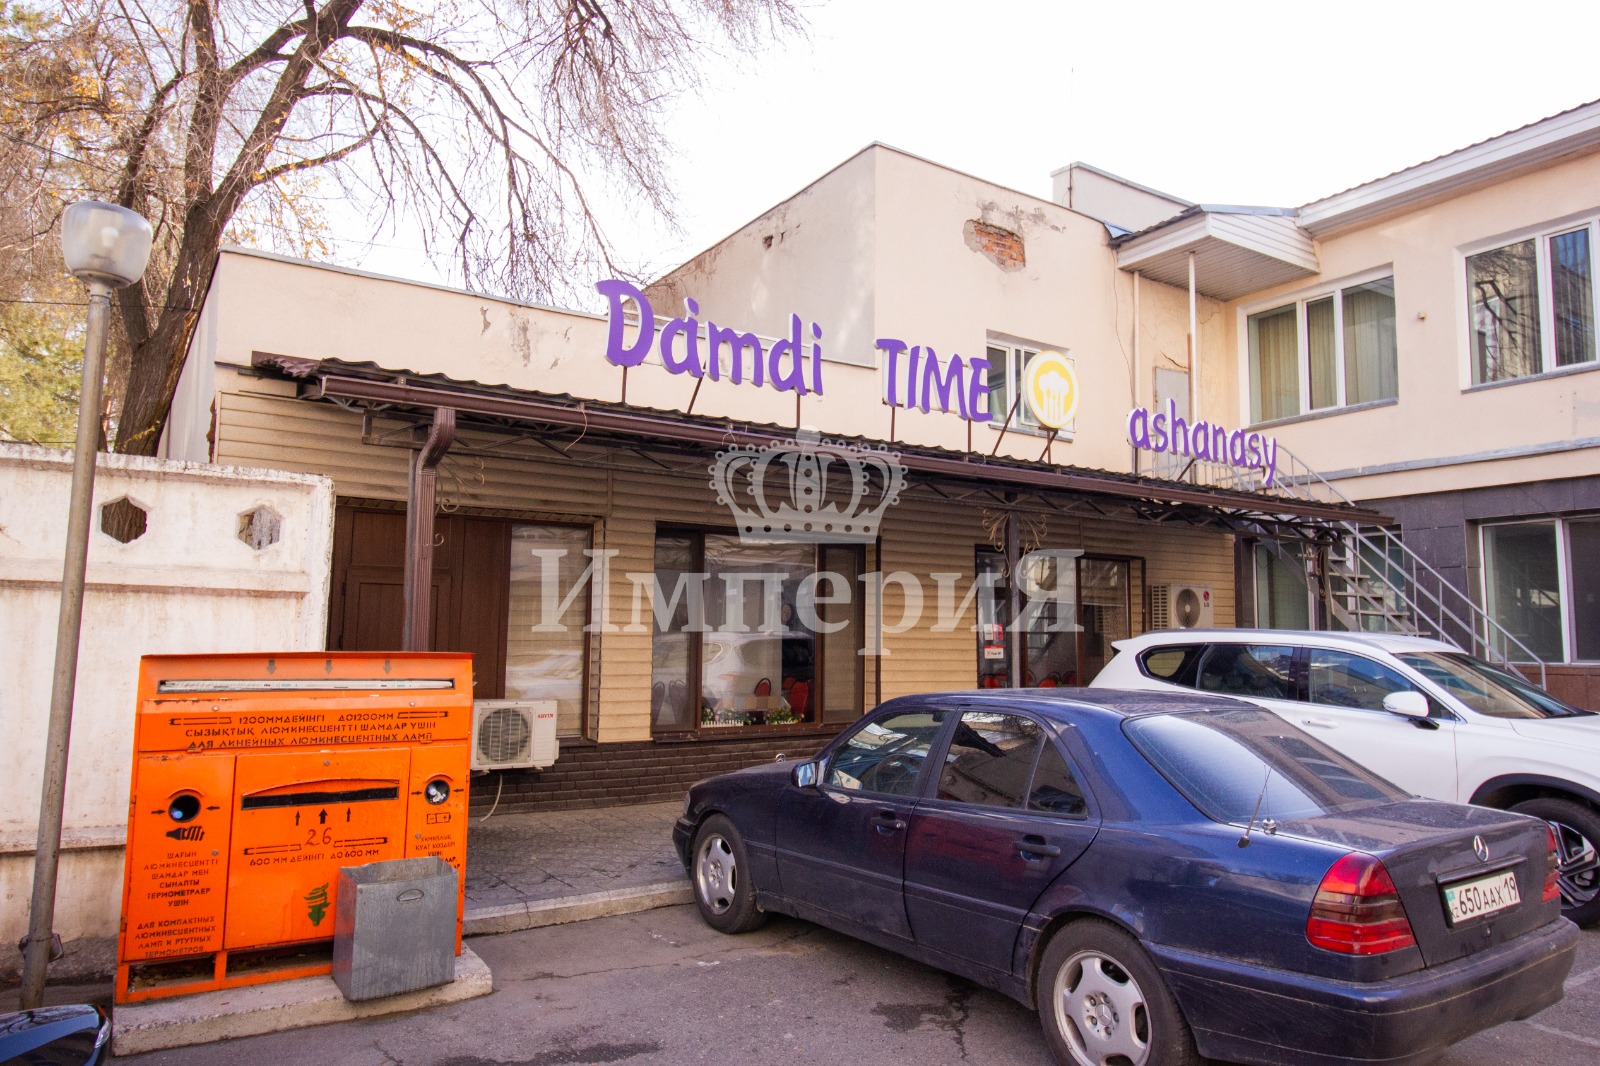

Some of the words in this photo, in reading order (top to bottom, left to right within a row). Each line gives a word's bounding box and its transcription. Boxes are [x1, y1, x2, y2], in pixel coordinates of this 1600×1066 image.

[873, 338, 993, 422] TIME
[1126, 398, 1276, 487] ashanasy
[260, 725, 358, 735] ЛЮМИНЕСЦЕНТТІ
[360, 722, 408, 731] ШАМДАР
[187, 740, 214, 749] ДЛЯ
[219, 737, 285, 748] ЛИНЕЙНЫХ
[290, 733, 398, 745] ЛЮМИНЕСЦЕНТНЫХ
[402, 732, 433, 741] ЛАМП
[249, 857, 270, 867] 600
[273, 856, 287, 865] ММ
[365, 848, 379, 857] ММ
[151, 870, 189, 880] ШАМДАР
[191, 869, 209, 877] МЕН
[159, 879, 200, 889] СЫНАПТЫ
[147, 887, 211, 900] ТЕРМОМЕТРЛЕР
[137, 921, 155, 930] ДЛЯ
[158, 915, 215, 928] КОМПАКТНЫХ
[135, 926, 216, 940] ЛЮМИНЕСЦЕНТНЫХ
[138, 940, 163, 950] ЛАМП
[166, 938, 172, 946] И
[175, 935, 212, 946] РТУТНЫХ
